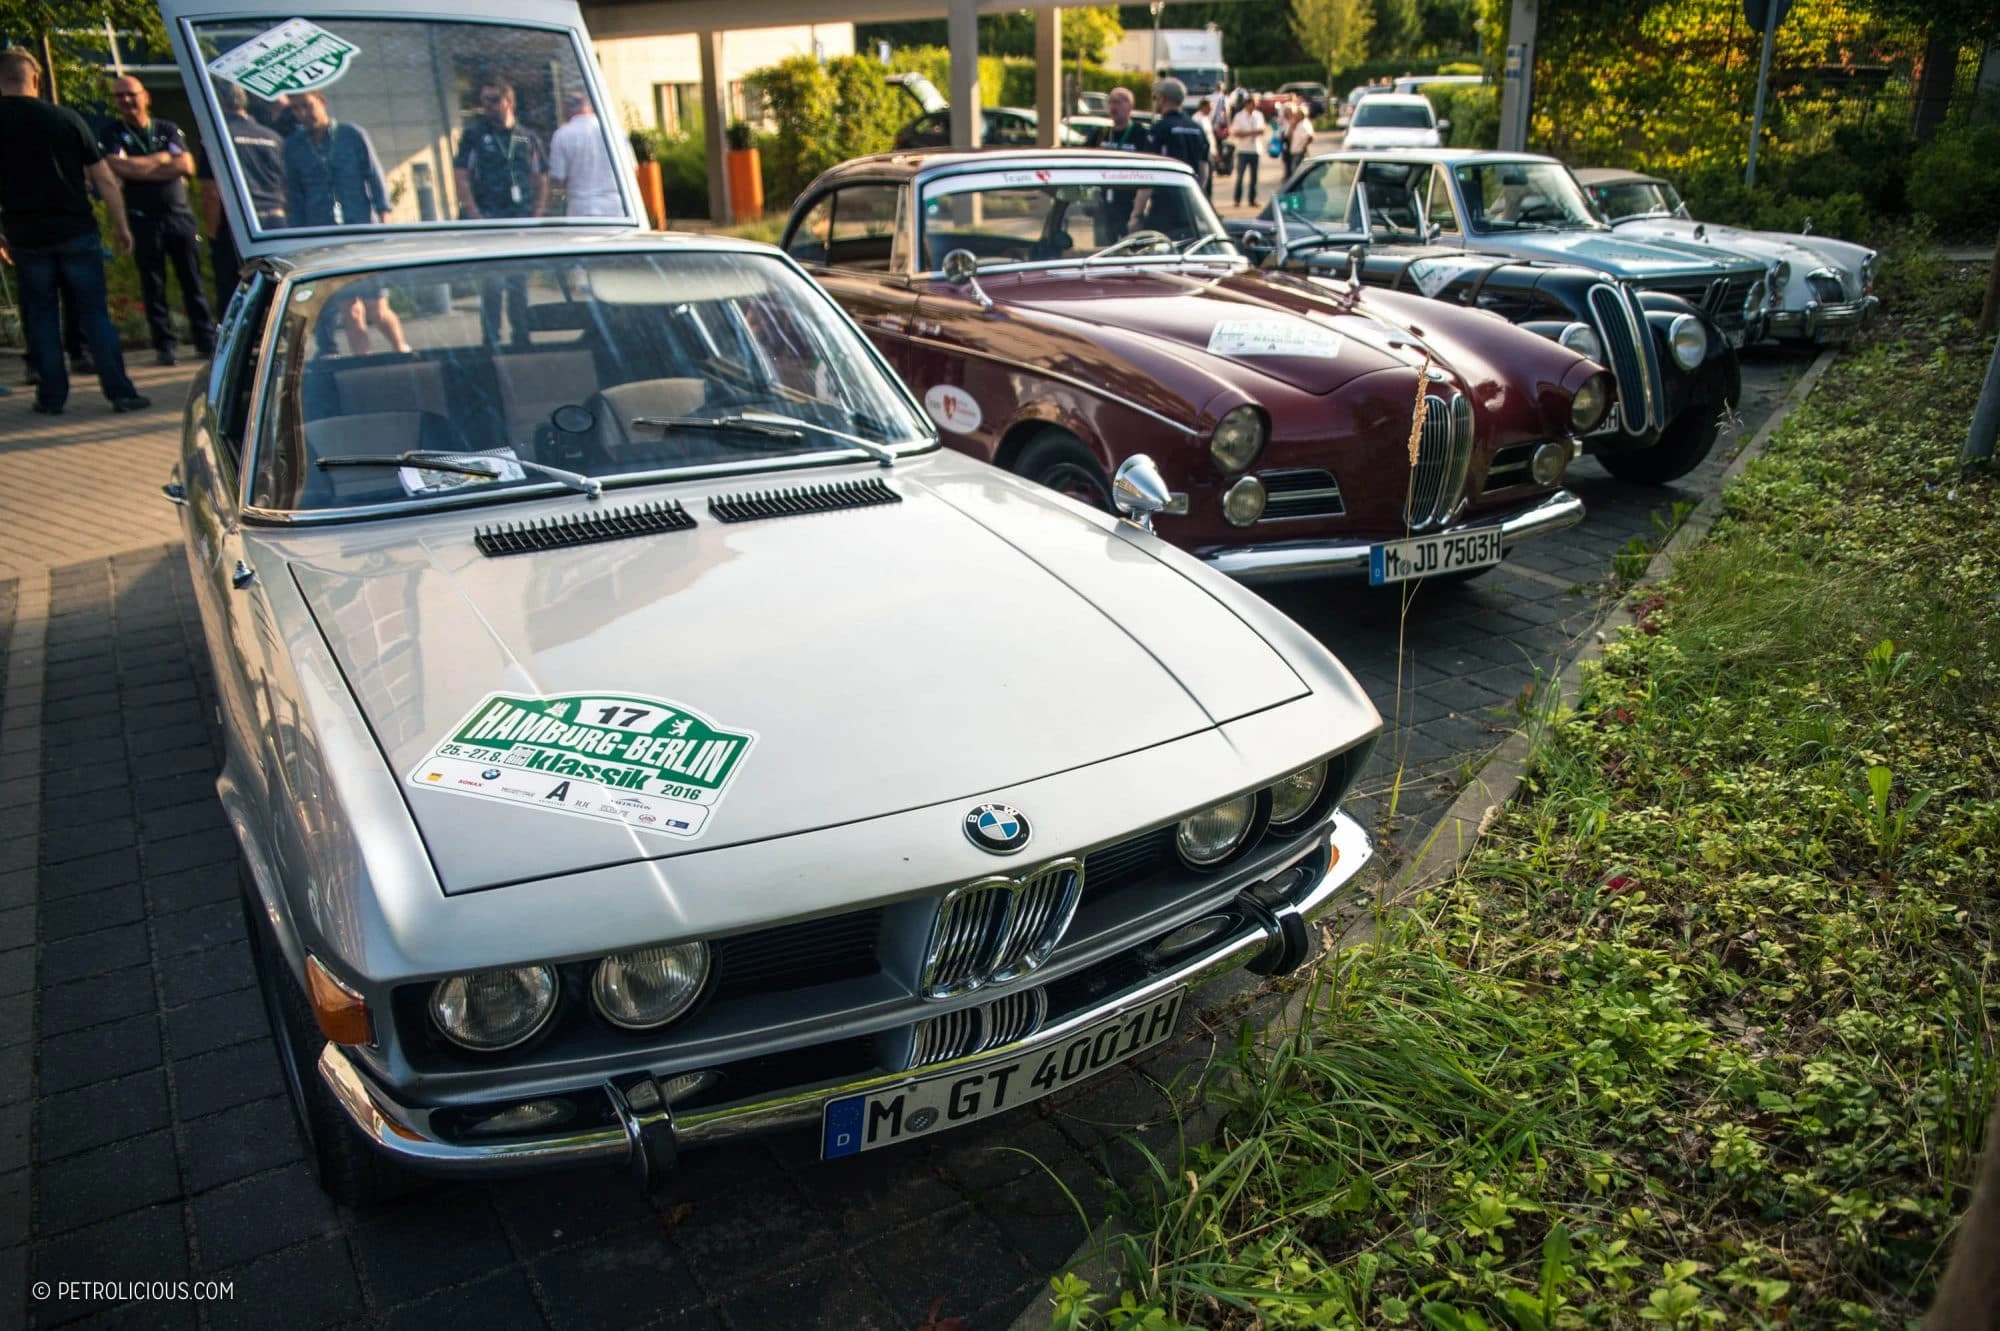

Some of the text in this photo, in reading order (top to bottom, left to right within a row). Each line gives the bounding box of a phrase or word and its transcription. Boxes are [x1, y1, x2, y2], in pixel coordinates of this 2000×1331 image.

[303, 65, 324, 81] 17
[1386, 548, 1399, 576] M
[1414, 542, 1438, 572] JD
[1443, 532, 1501, 568] 7503H
[598, 706, 651, 728] 17
[464, 701, 738, 784] HAMBURG-BERLIN
[525, 749, 653, 791] klassik
[545, 781, 571, 802] A
[660, 783, 702, 800] 2016
[837, 996, 1179, 1147] D M GT 4001H
